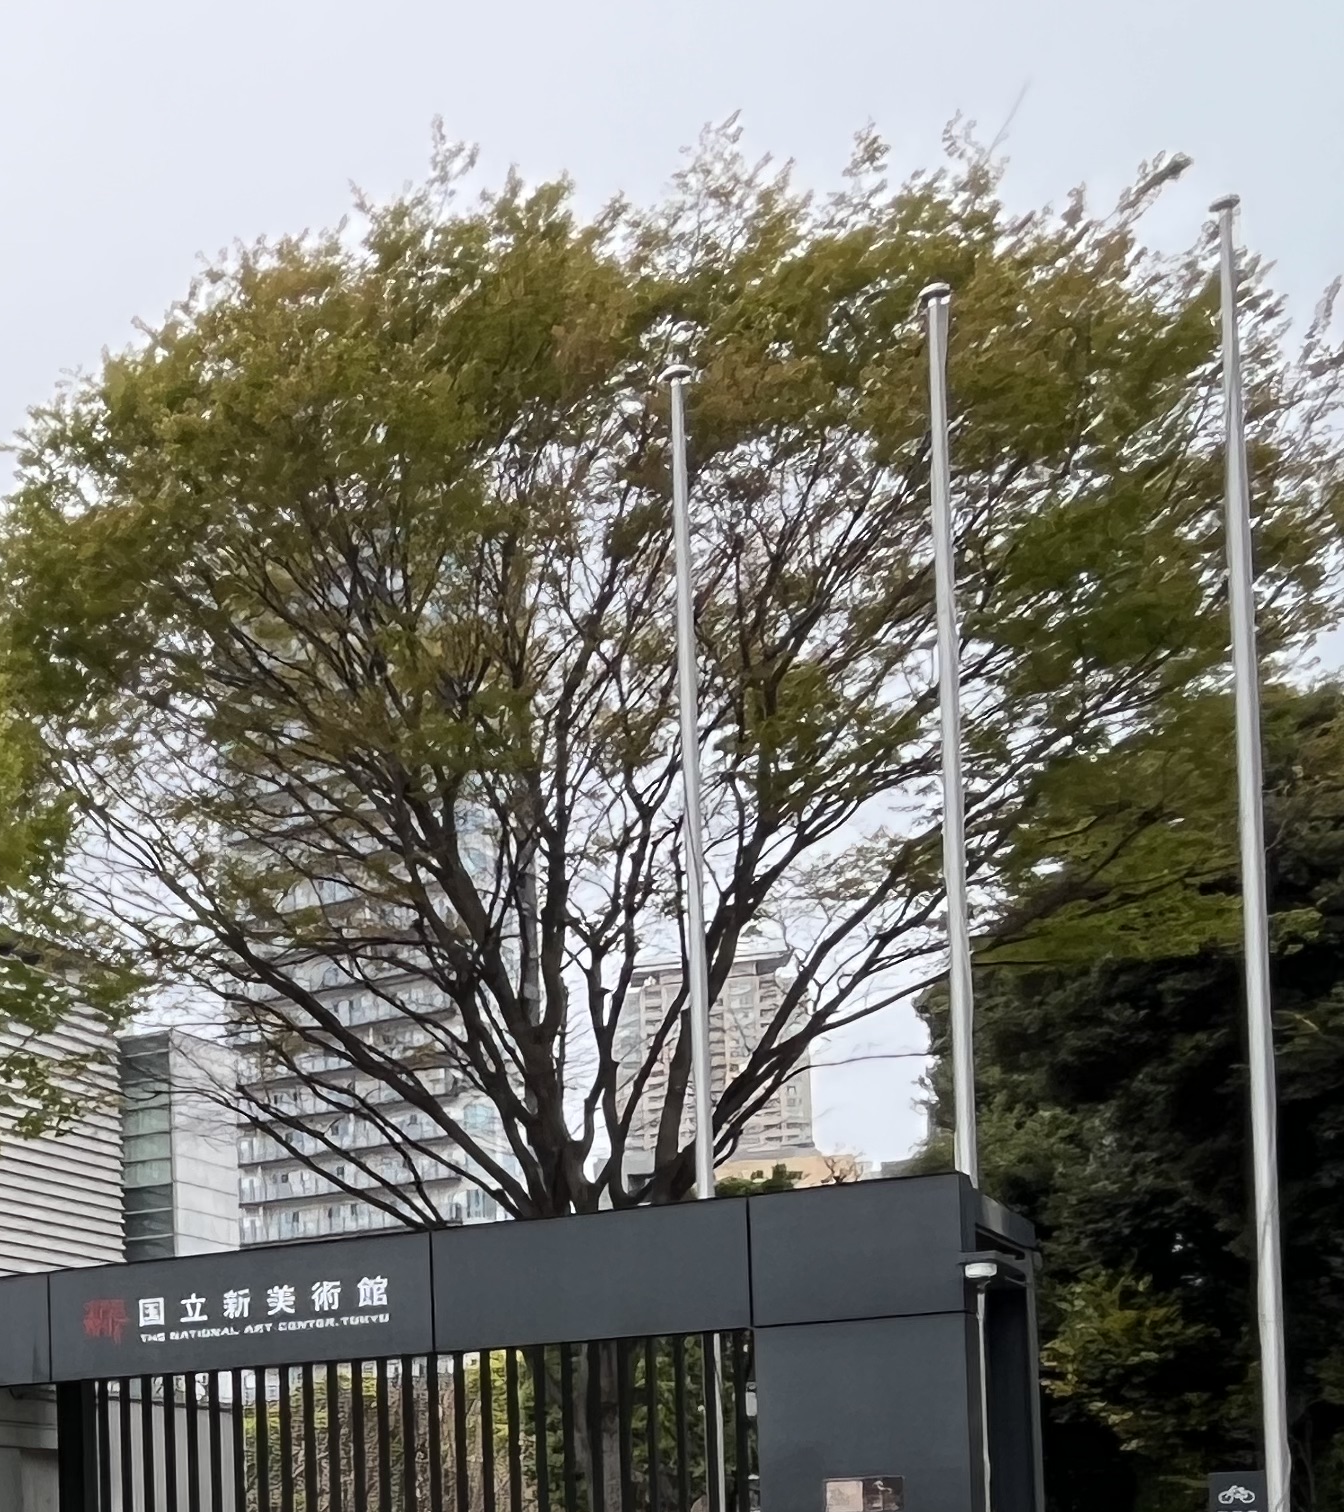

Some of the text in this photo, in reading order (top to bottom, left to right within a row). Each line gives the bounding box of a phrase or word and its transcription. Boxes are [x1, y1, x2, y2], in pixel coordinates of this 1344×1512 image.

[138, 1276, 389, 1327] 国立新美術館
